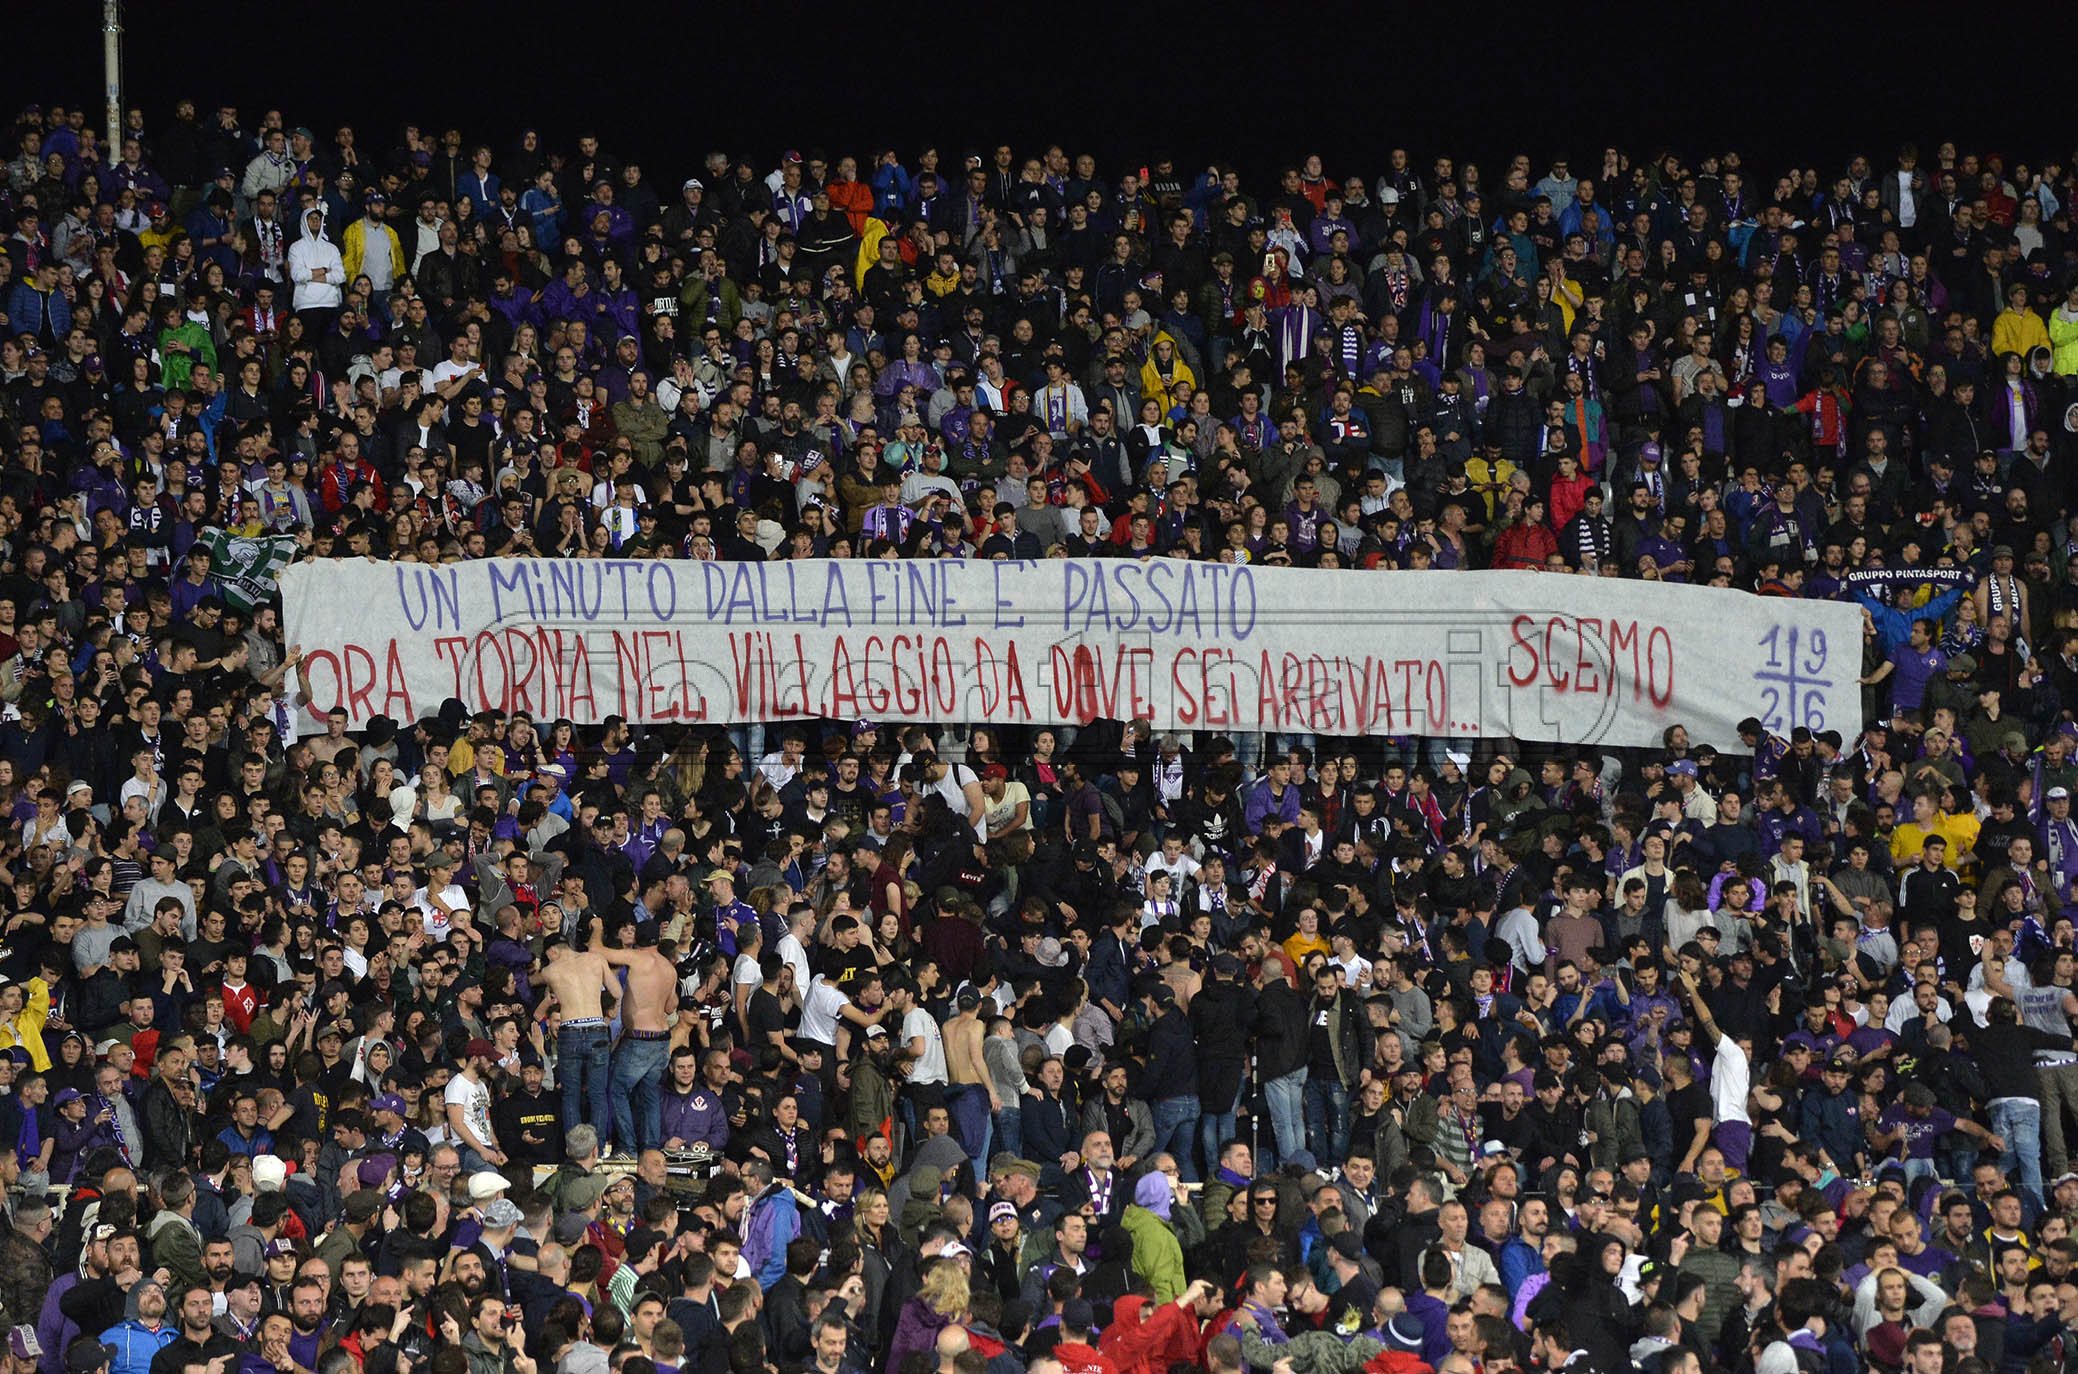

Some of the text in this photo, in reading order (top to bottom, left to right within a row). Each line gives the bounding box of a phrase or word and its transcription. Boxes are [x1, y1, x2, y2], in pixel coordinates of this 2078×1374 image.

[397, 567, 461, 630] UN
[703, 561, 851, 627] DALLA
[1064, 562, 1257, 640] PASSATO
[1848, 569, 1962, 581] GRUPPO PINTASPORT
[304, 639, 414, 723] ORA
[434, 625, 596, 721] TORNA
[612, 630, 707, 720] NEL
[976, 637, 1032, 720] DA
[1052, 644, 1154, 724] DOVE
[1508, 614, 1674, 709] SCEMO
